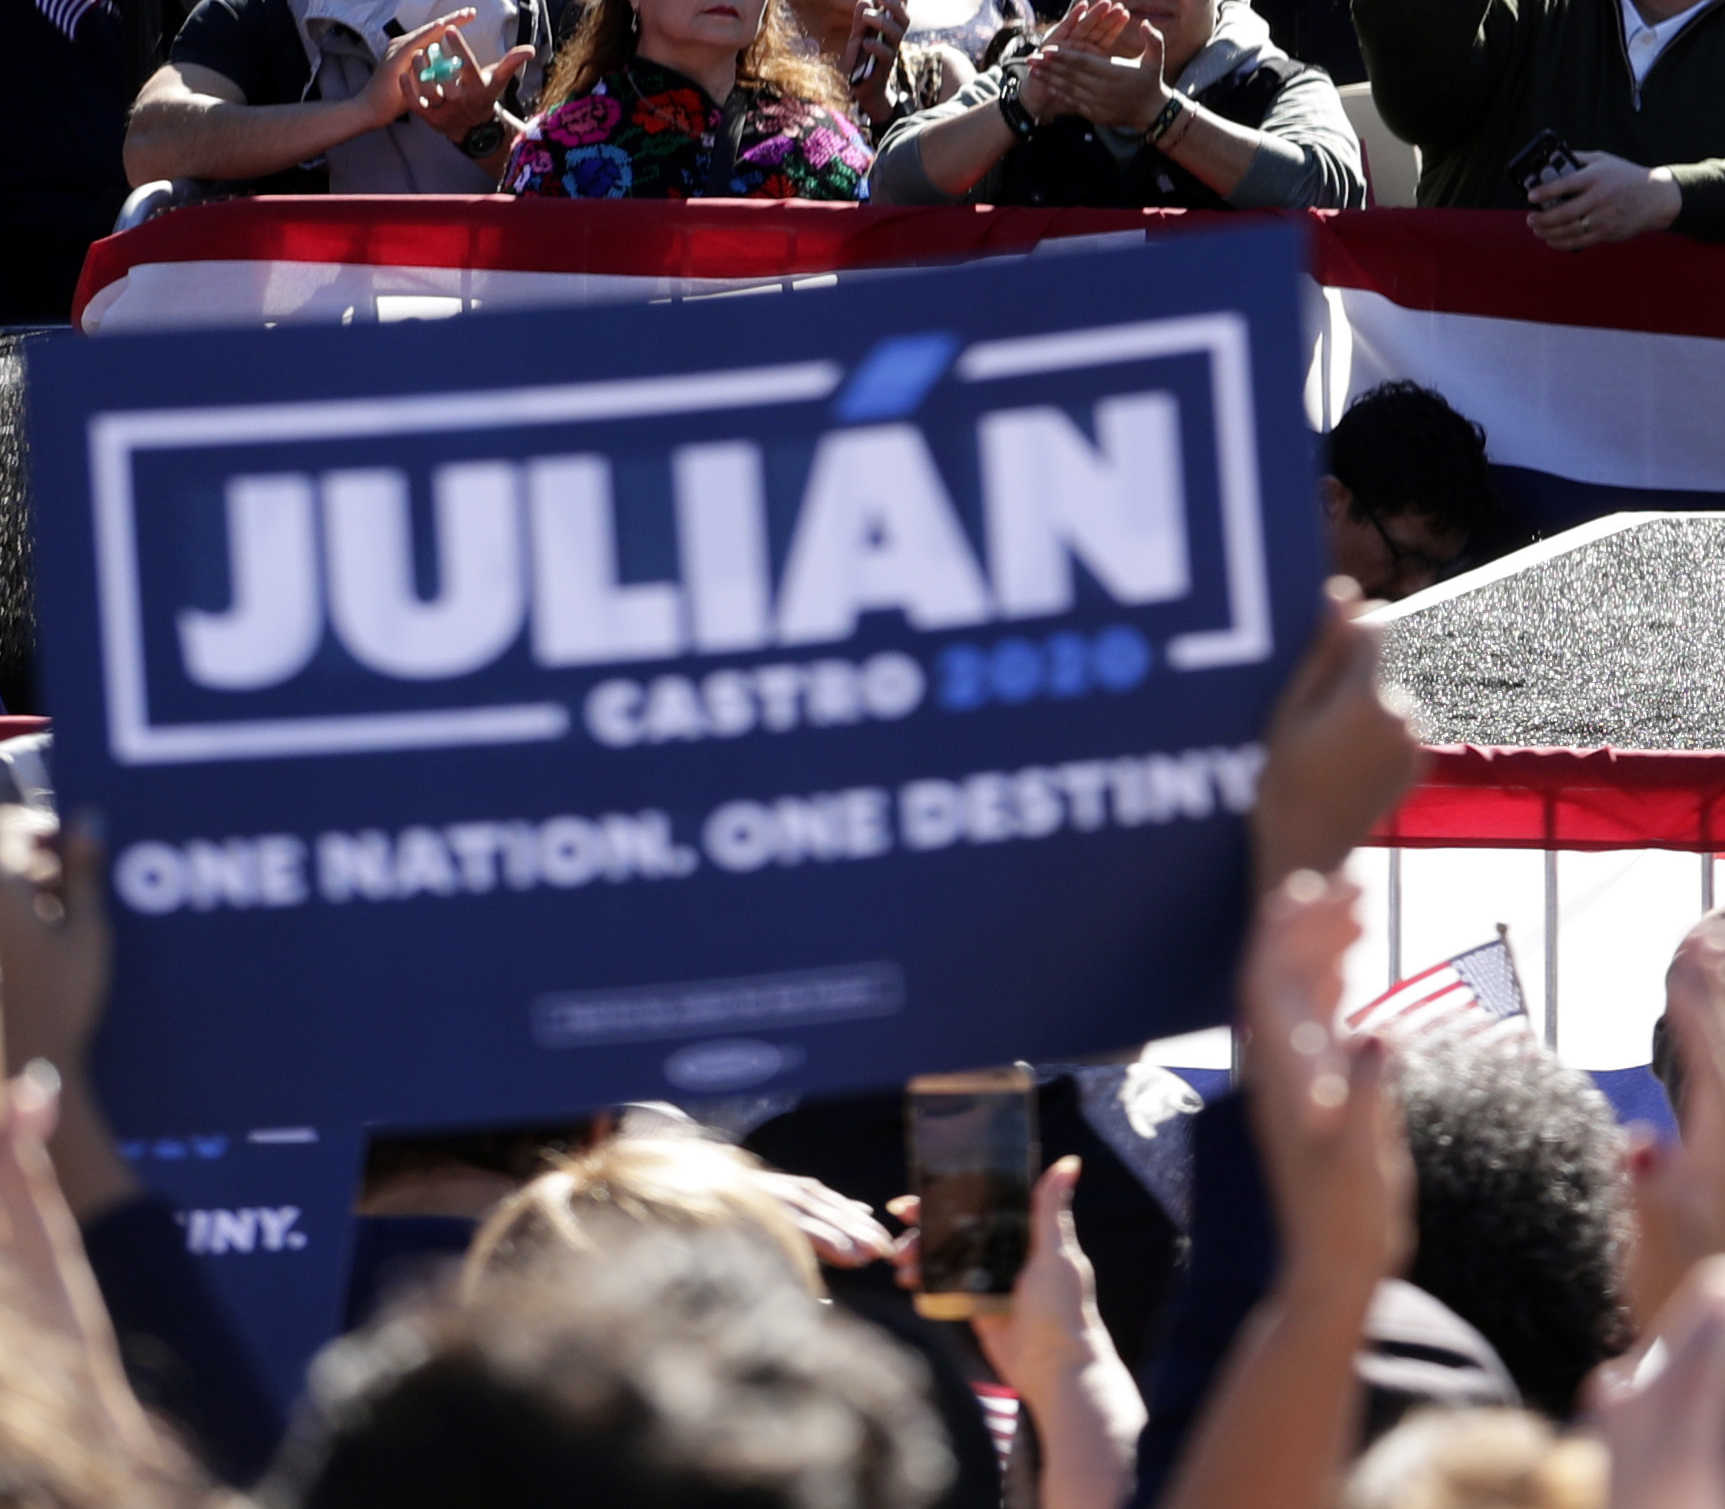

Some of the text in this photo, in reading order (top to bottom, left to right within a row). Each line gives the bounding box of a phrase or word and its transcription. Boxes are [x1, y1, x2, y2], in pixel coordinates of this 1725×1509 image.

[177, 334, 1191, 690] JULIÁN
[583, 623, 1151, 748] CASTRO 2020
[114, 832, 308, 916] ONE
[317, 810, 698, 905] NATION.
[701, 785, 892, 873] ONE
